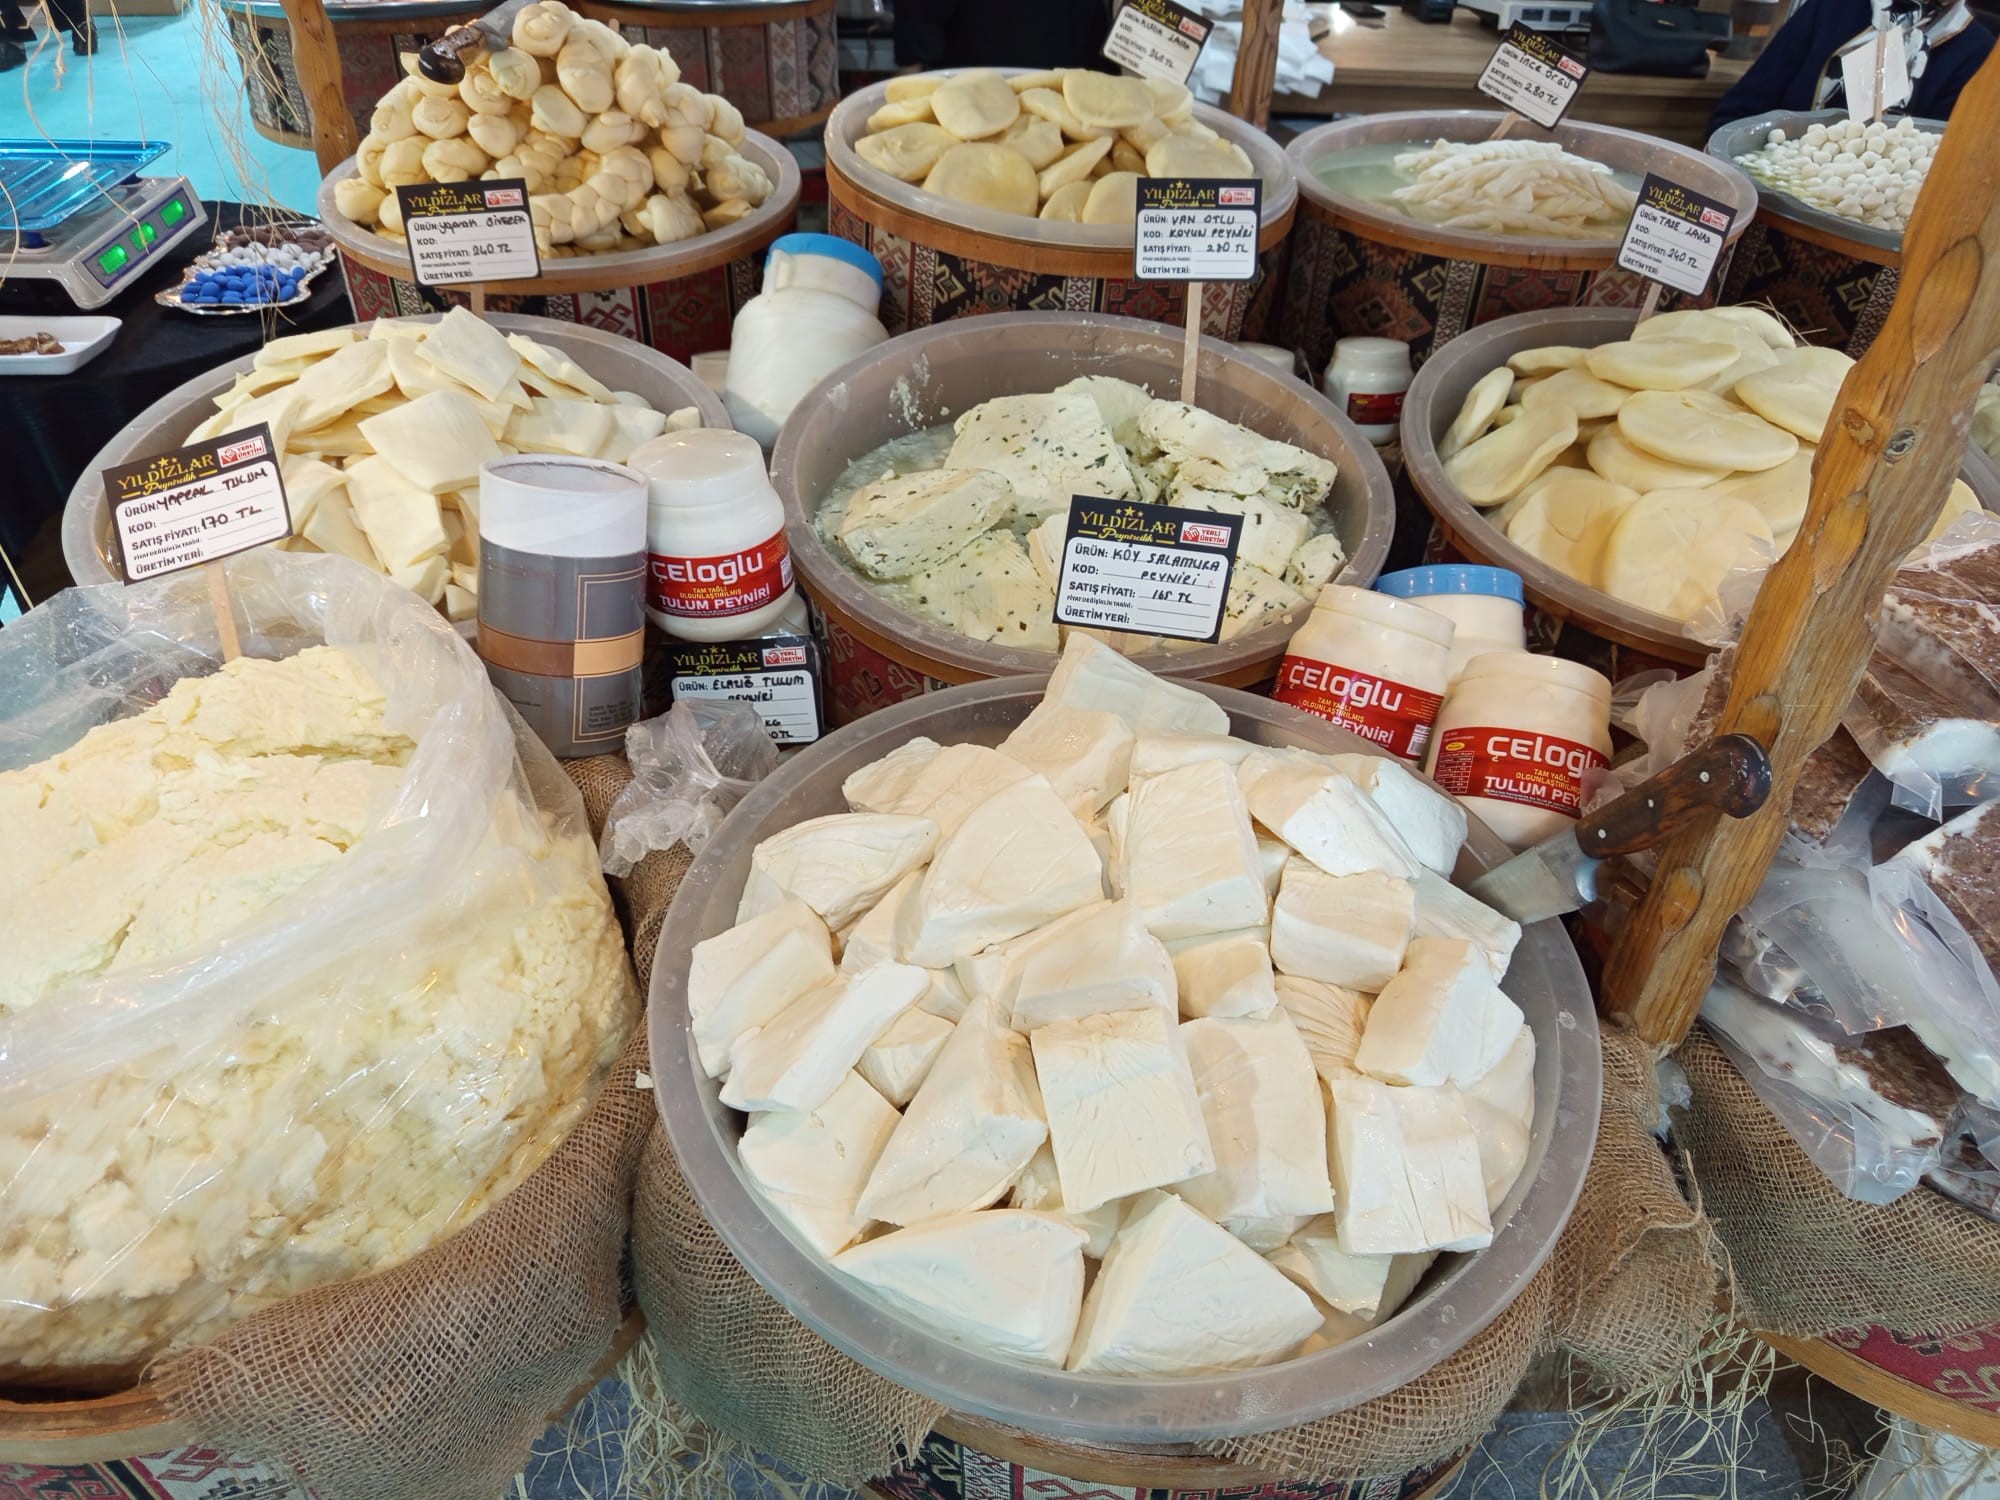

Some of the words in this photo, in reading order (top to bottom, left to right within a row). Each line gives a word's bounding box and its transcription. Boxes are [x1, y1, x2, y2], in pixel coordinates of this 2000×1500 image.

[408, 193, 482, 208] YILDIZLAR
[1144, 188, 1216, 200] YILDIZLAR
[1649, 186, 1700, 216] YILDIZLAR
[1143, 215, 1168, 224] ÜRÜN:
[1171, 215, 1196, 225] VAN
[1203, 215, 1235, 225] OTLU
[1143, 231, 1163, 239] KOD:
[1169, 228, 1207, 238] KOYUN
[472, 243, 495, 256] 240
[1142, 245, 1165, 255] SATIŞ
[1235, 243, 1249, 253] TL
[1667, 248, 1687, 263] 240
[117, 453, 215, 491] YILDIZLAR
[124, 501, 159, 518] ÜRÜN:
[128, 520, 157, 535] KOD:
[131, 534, 163, 551] SATIŞ
[164, 525, 201, 542] FİYATI:
[201, 513, 229, 531] 170
[236, 505, 263, 519] TL
[1080, 511, 1177, 536] YILDIZLAR
[135, 558, 176, 574] ÜRETİM
[176, 549, 204, 564] YERİ:
[1075, 543, 1108, 558] ÜRÜN:
[1112, 543, 1141, 562] KÖY
[1147, 552, 1220, 571] SALAMURA
[1072, 563, 1099, 575] KOD:
[659, 594, 709, 610] TULUM
[715, 583, 771, 610] PEYNİRİ
[679, 588, 742, 600] OLGUNLAŞTIRILMIŞ
[692, 586, 707, 594] TAM
[708, 586, 728, 594] YAĞLI
[1069, 581, 1099, 595] SATIŞ
[1100, 582, 1136, 598] FİYATI:
[1178, 592, 1193, 604] TL
[1064, 605, 1103, 621] ÜRETİM
[1103, 610, 1130, 624] YERİ:
[673, 652, 759, 666] YILDIZLAR
[679, 682, 709, 692] ÜRÜN:
[762, 676, 805, 687] TULUM
[1318, 697, 1332, 706] TAM
[1534, 768, 1550, 777] TAM
[1485, 776, 1546, 798] TULUM
